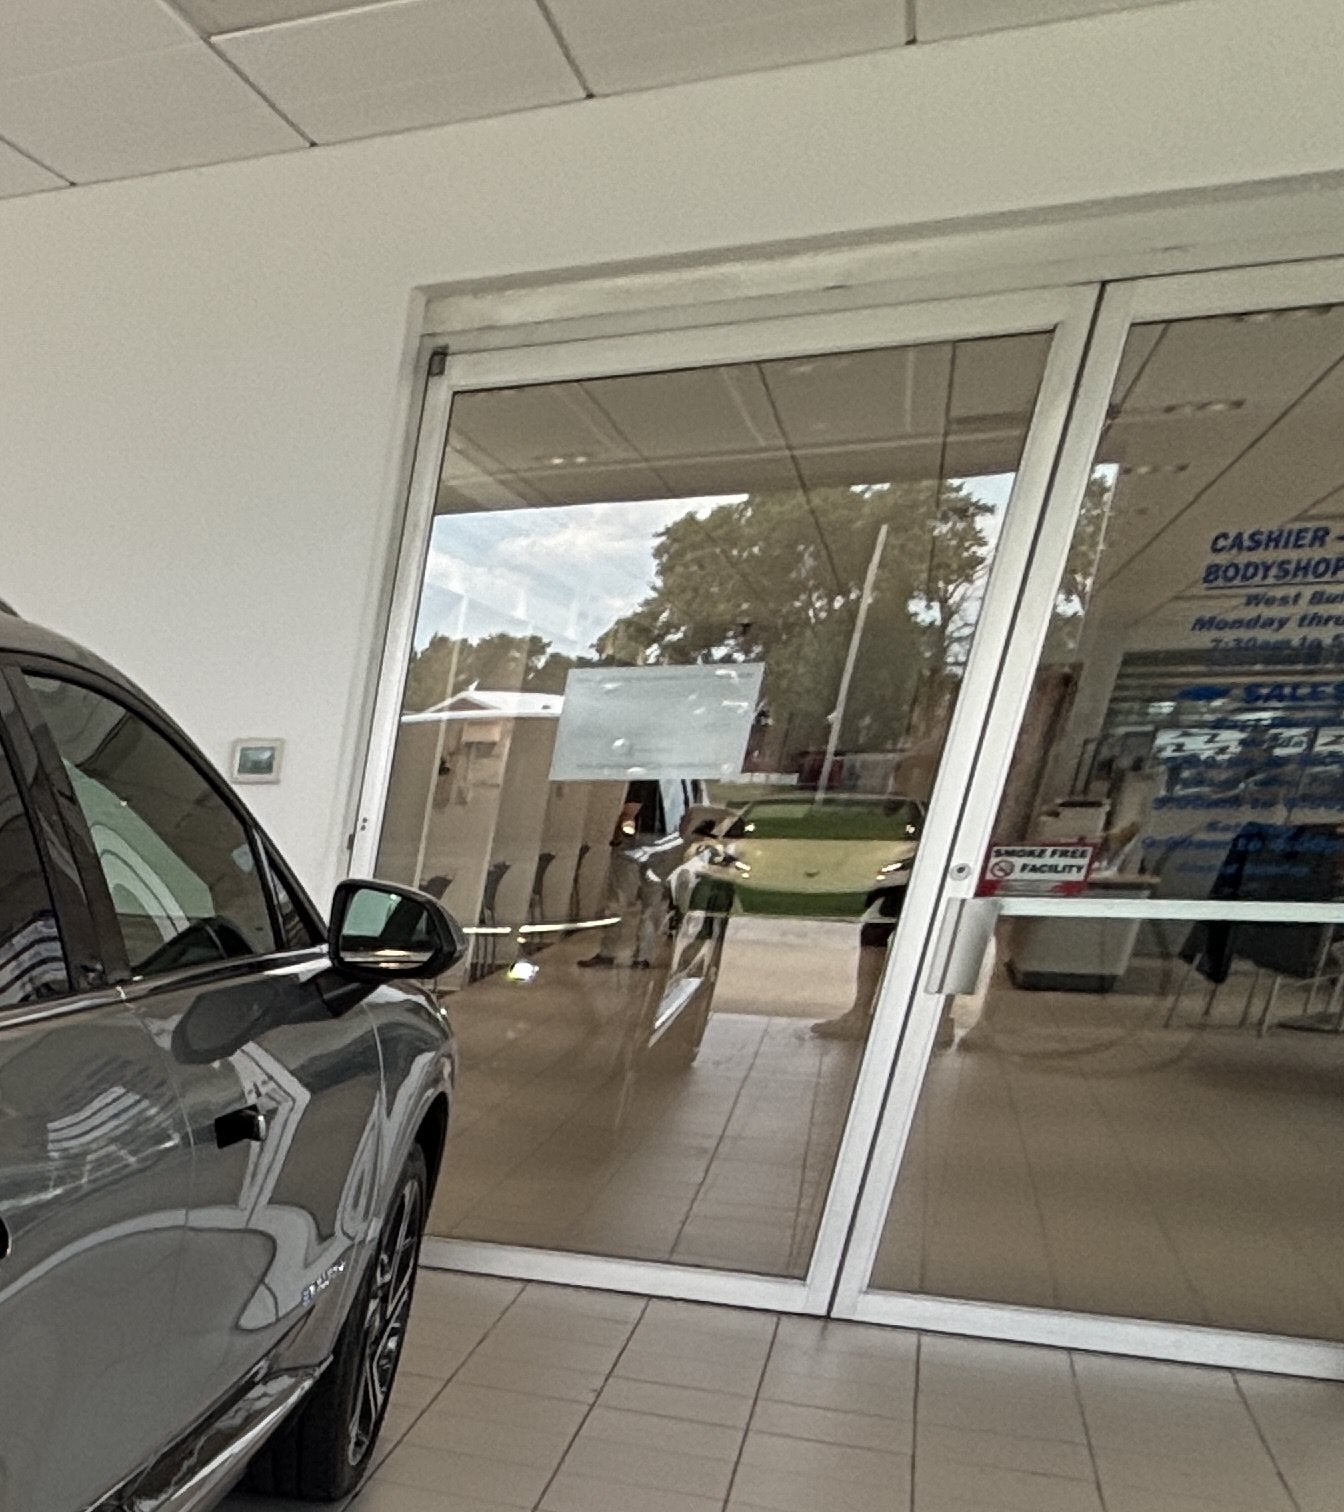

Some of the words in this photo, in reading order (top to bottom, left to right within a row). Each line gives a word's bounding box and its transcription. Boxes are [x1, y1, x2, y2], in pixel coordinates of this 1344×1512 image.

[1211, 527, 1330, 553] CASHIER
[1203, 557, 1344, 583] BODYSHOP
[1244, 592, 1301, 607] West
[1191, 614, 1291, 632] Monday
[994, 848, 1047, 859] SMOKE
[1049, 848, 1089, 859] FREE
[1019, 863, 1084, 874] FACILITY
